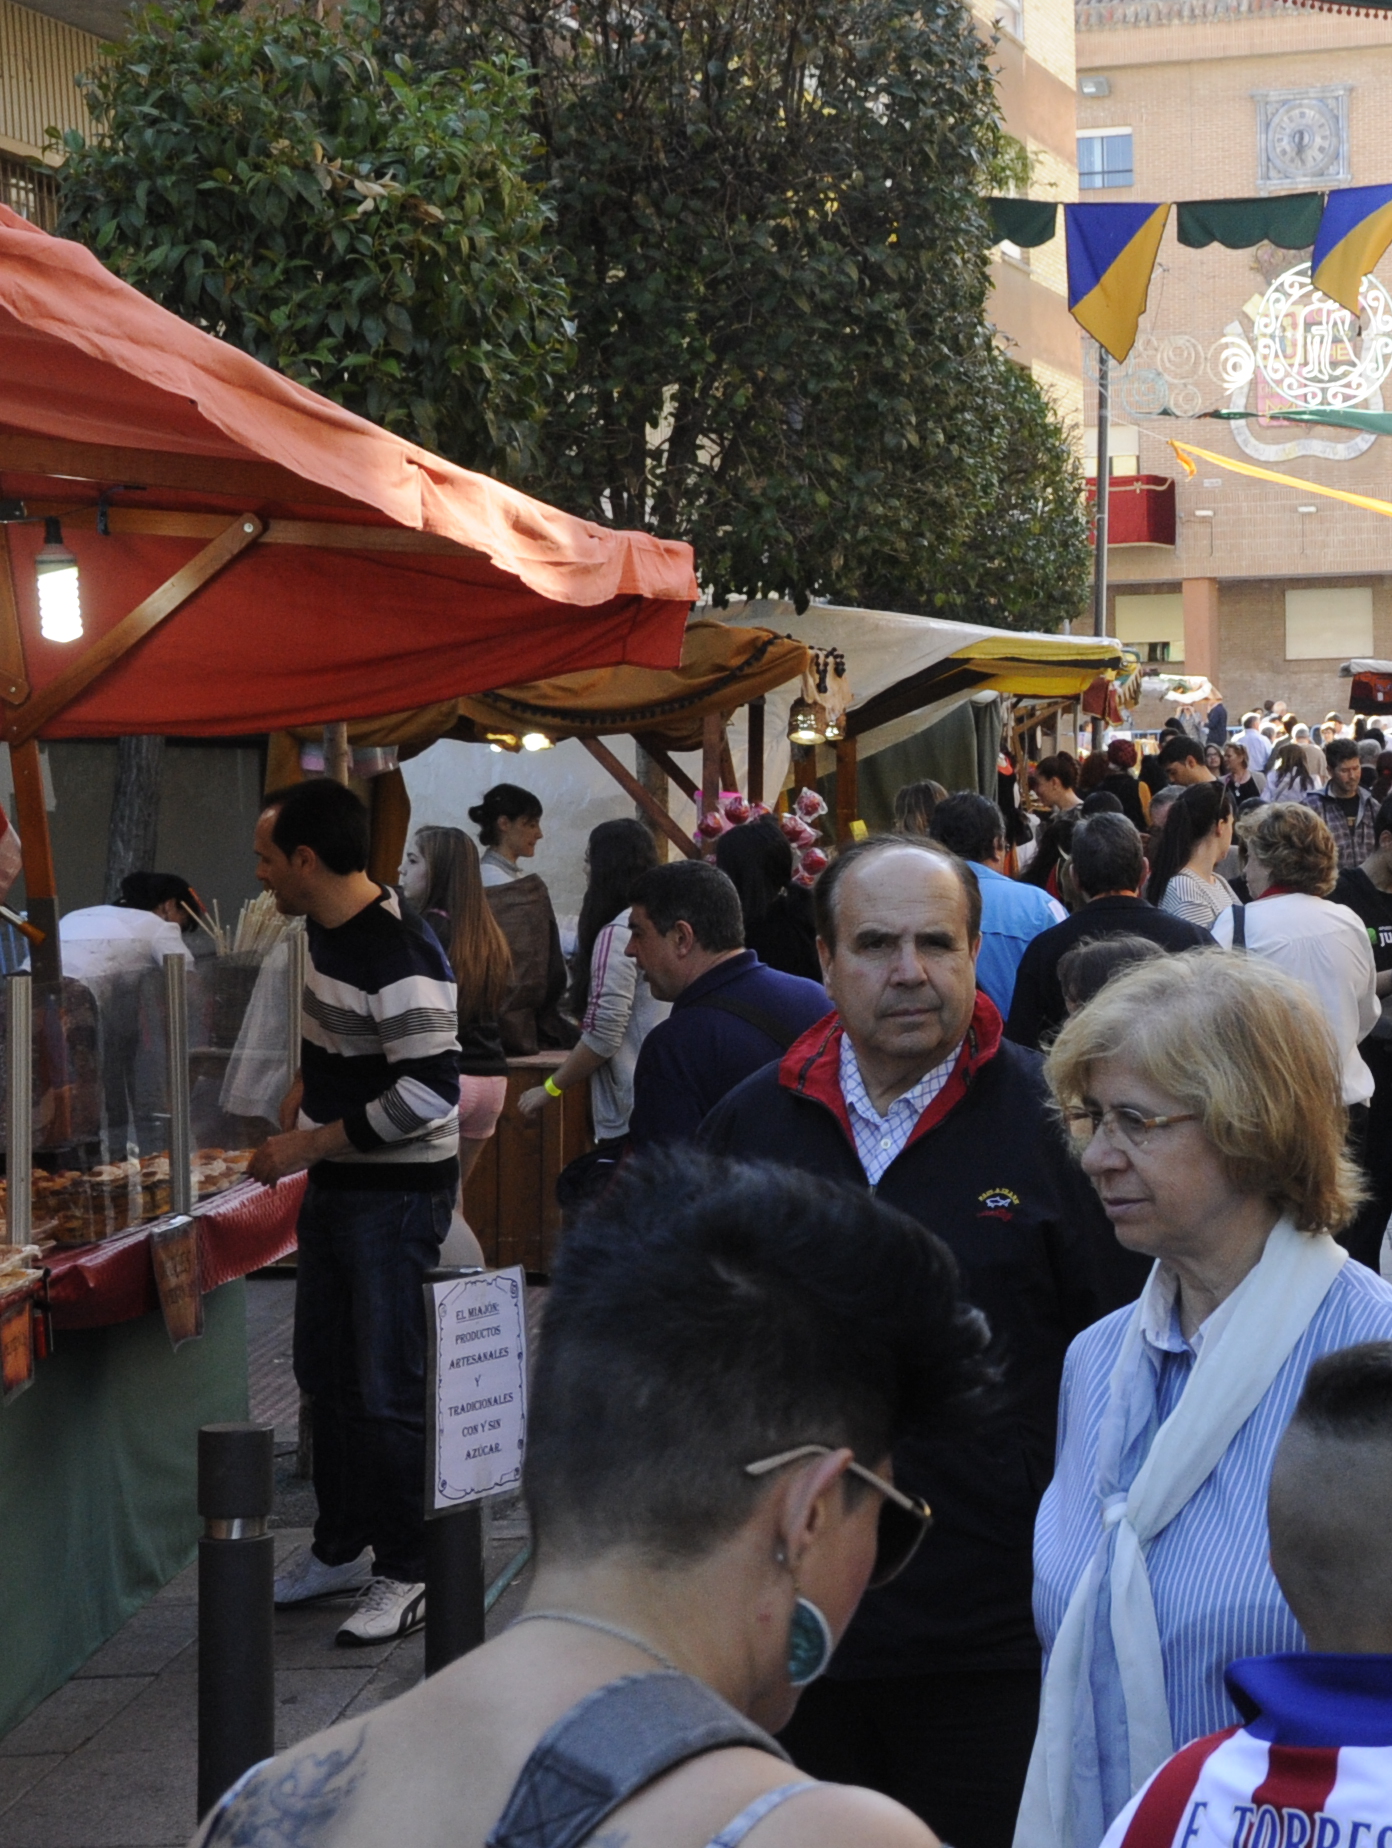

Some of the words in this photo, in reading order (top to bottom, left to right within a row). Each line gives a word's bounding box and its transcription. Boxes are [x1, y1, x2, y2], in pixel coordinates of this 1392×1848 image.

[456, 1310, 467, 1321] EL
[455, 1325, 501, 1345] PRODUCTOS
[449, 1346, 509, 1370] ARTESANALES
[474, 1374, 482, 1388] Y
[448, 1392, 514, 1417] TRADICIONALES
[462, 1424, 479, 1438] CON
[480, 1419, 488, 1433] Y
[488, 1418, 502, 1431] SIN
